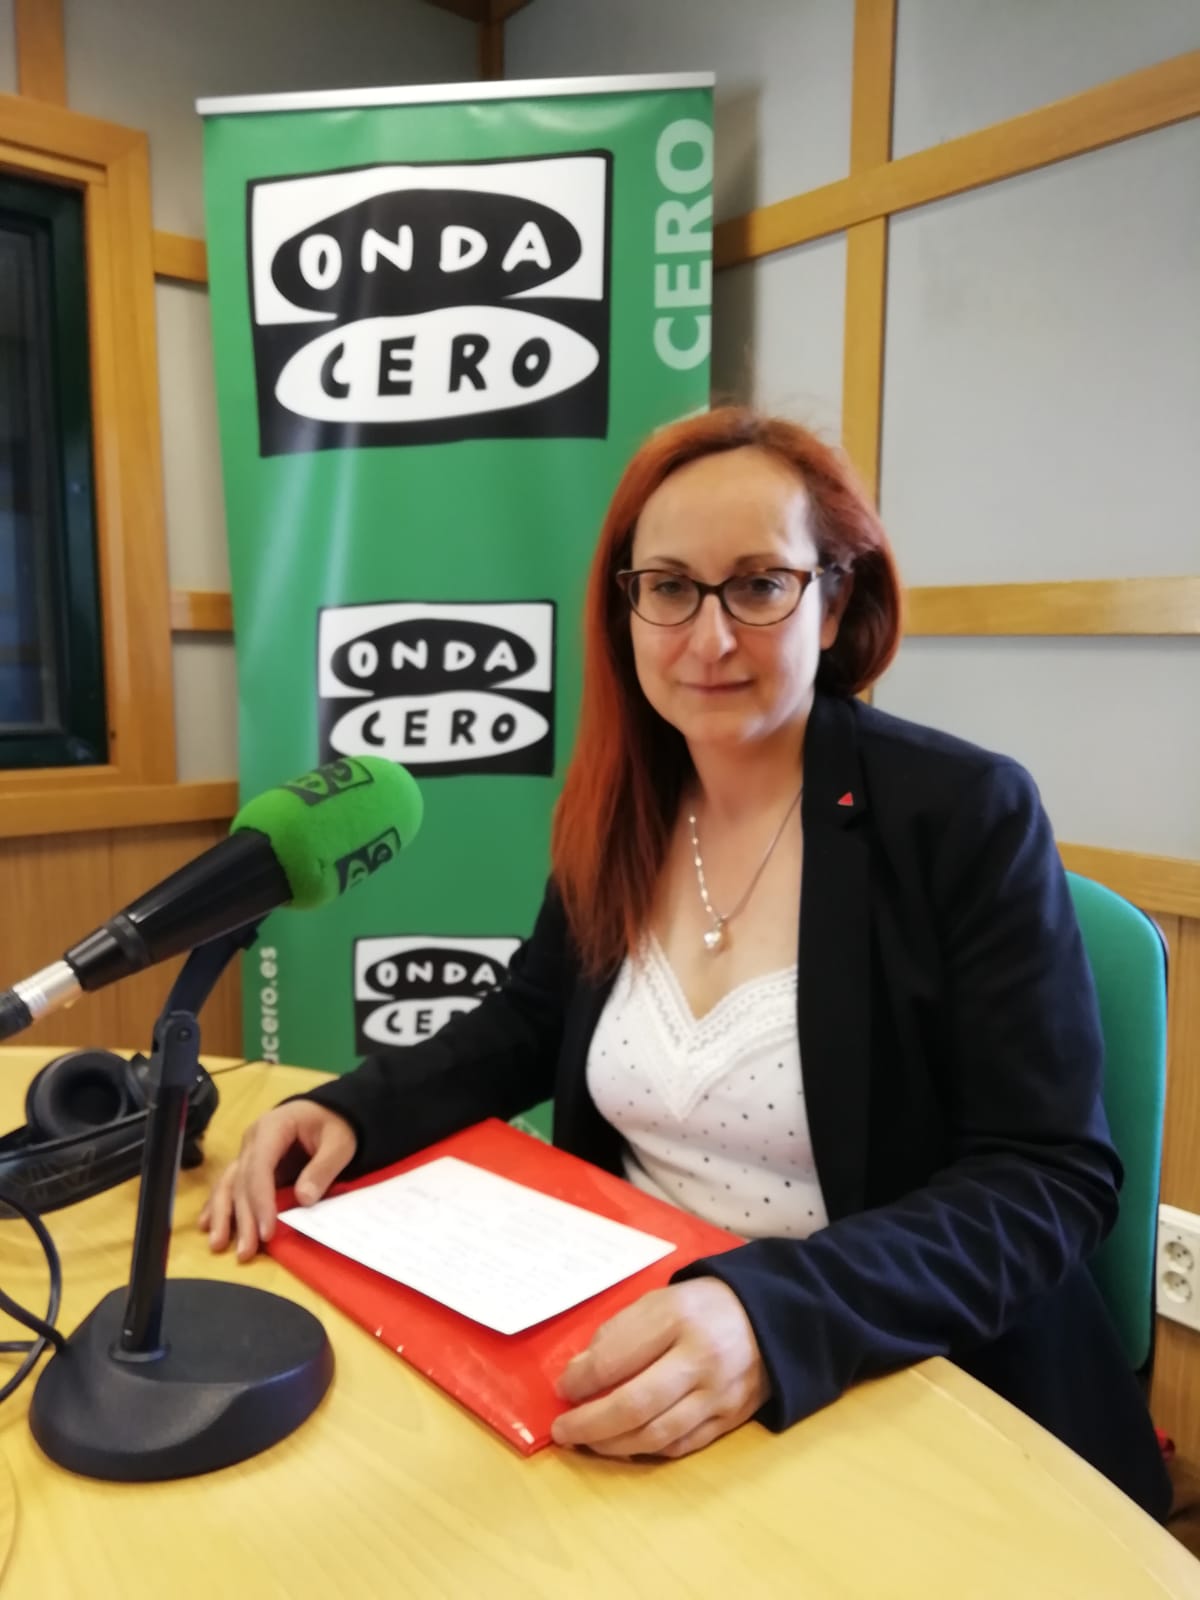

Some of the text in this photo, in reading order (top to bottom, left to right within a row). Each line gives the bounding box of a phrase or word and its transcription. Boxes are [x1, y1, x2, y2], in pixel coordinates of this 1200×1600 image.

[299, 221, 551, 291] ONDA
[652, 118, 713, 371] CERO
[320, 333, 552, 399] CERO
[348, 640, 518, 677] ONDA
[361, 708, 517, 747] CERO
[376, 961, 497, 987] ONDA
[385, 1009, 458, 1035] CE
